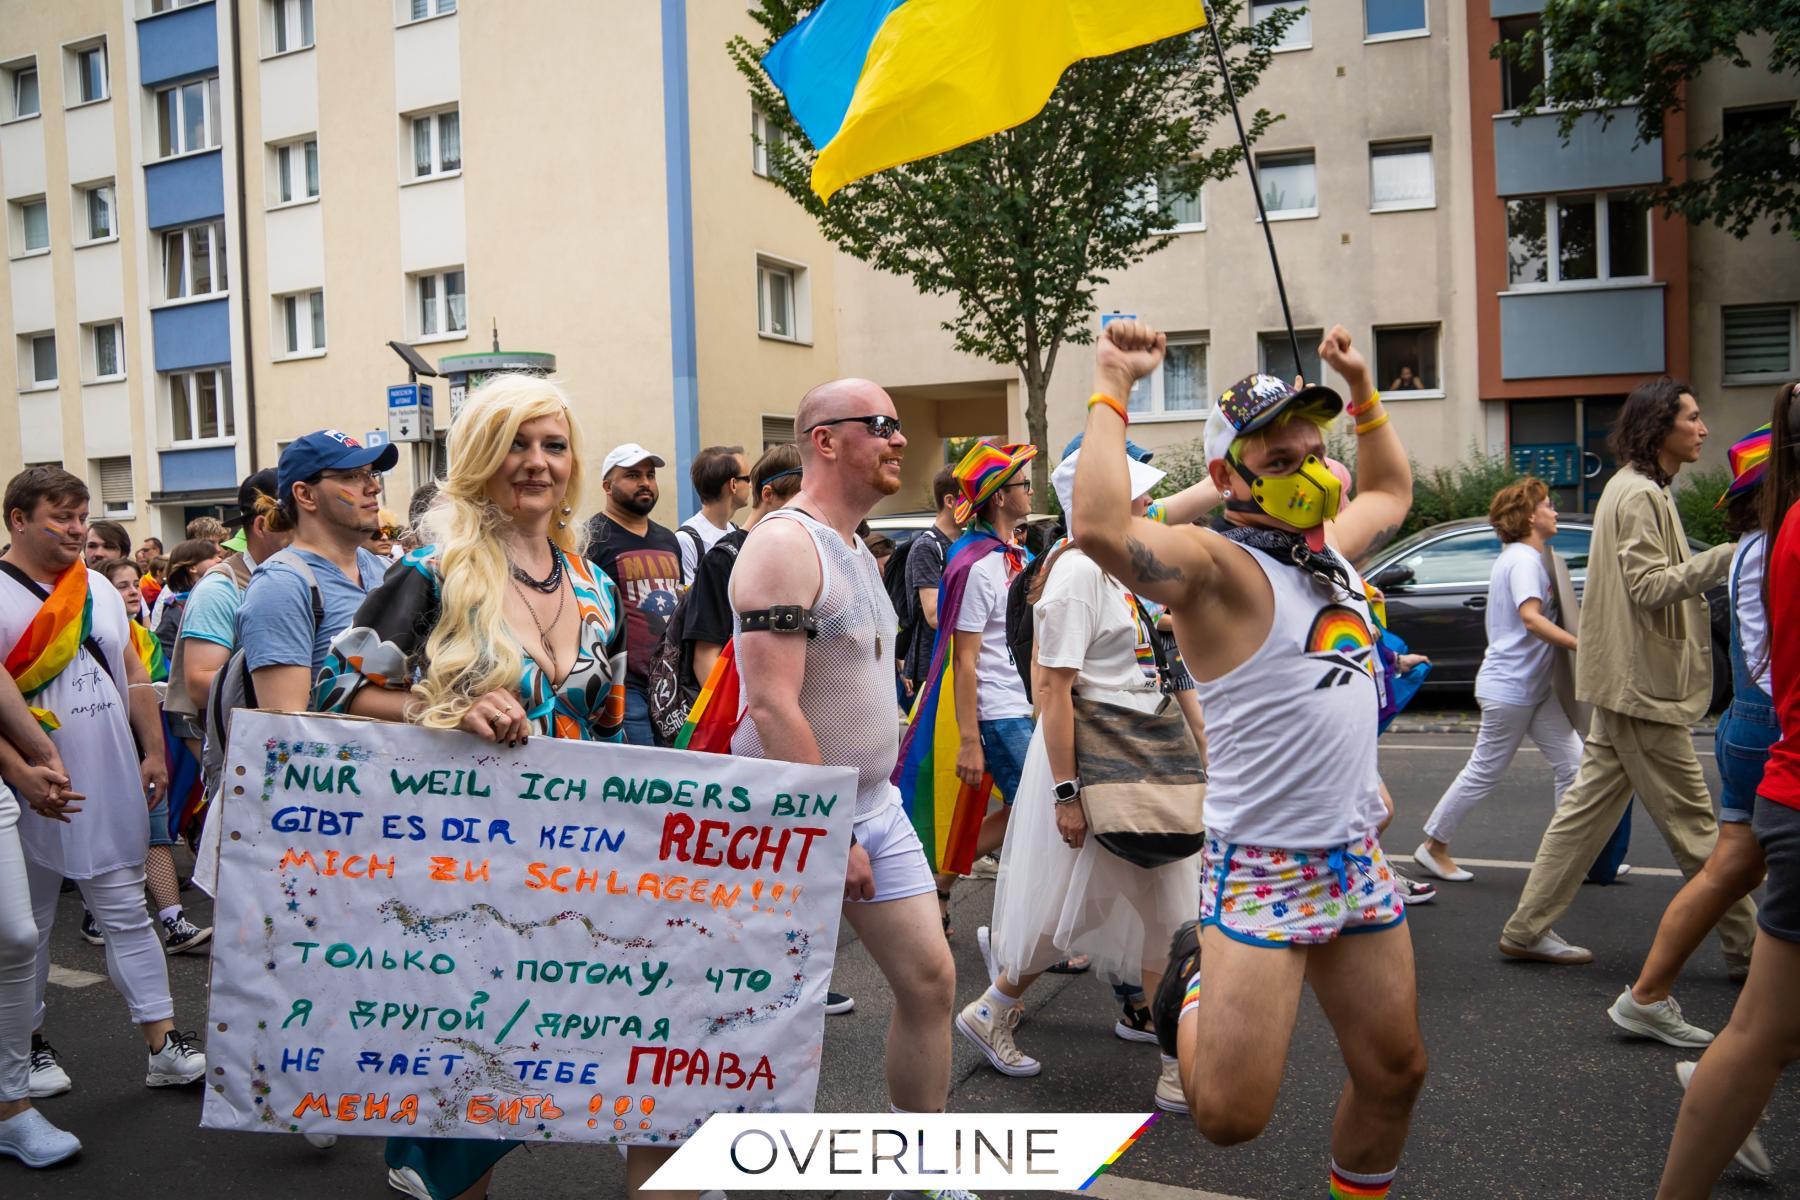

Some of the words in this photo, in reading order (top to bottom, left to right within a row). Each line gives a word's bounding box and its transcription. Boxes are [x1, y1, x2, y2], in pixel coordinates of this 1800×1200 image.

[654, 578, 680, 606] TH
[284, 764, 361, 795] NUR
[390, 769, 491, 798] WEIL
[518, 772, 587, 801] ICH
[602, 776, 752, 813] ANDERS
[771, 793, 837, 818] BIN
[271, 806, 363, 836] GIBT
[383, 815, 426, 841] ES
[441, 817, 516, 845] DIR
[539, 825, 626, 853] KEIN
[659, 811, 828, 873] RECHT
[279, 848, 395, 880] MICH
[427, 856, 490, 882] ZU
[292, 941, 456, 975] ТОЛЬКО
[516, 959, 673, 997] ПОТОМУ,
[705, 967, 772, 993] ЧТО
[281, 998, 313, 1030] Я
[280, 1048, 325, 1073] НЕ
[356, 1048, 464, 1076] ДАЁТ
[513, 1059, 599, 1085] ТЕБЕ
[626, 1046, 776, 1091] ПРАВА
[292, 1091, 419, 1125] МЕНЯ
[465, 1094, 565, 1126] БИТЬ
